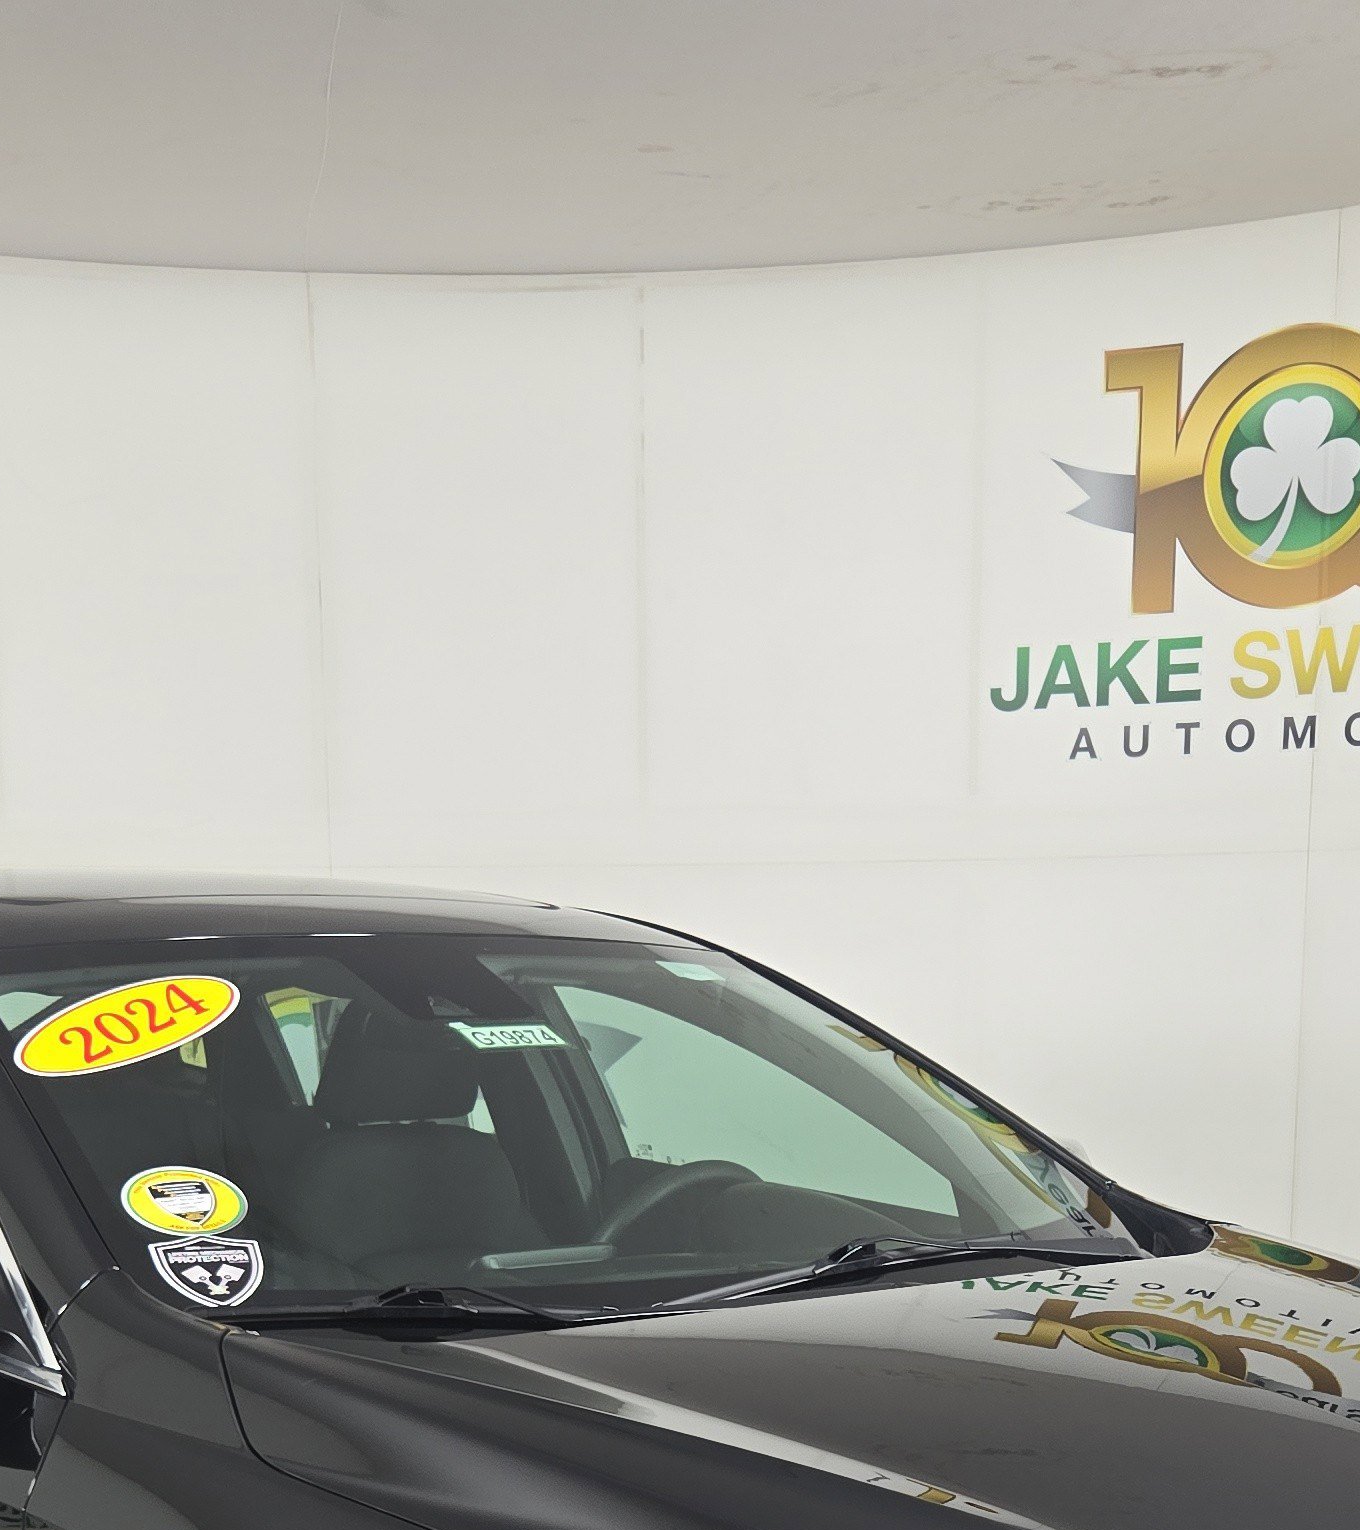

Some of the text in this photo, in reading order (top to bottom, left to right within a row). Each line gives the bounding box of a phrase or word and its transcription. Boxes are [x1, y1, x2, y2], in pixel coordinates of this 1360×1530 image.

[990, 636, 1203, 712] JAKE
[59, 984, 211, 1064] 2024
[472, 1029, 558, 1046] G19874
[168, 1254, 250, 1264] PROTECTION
